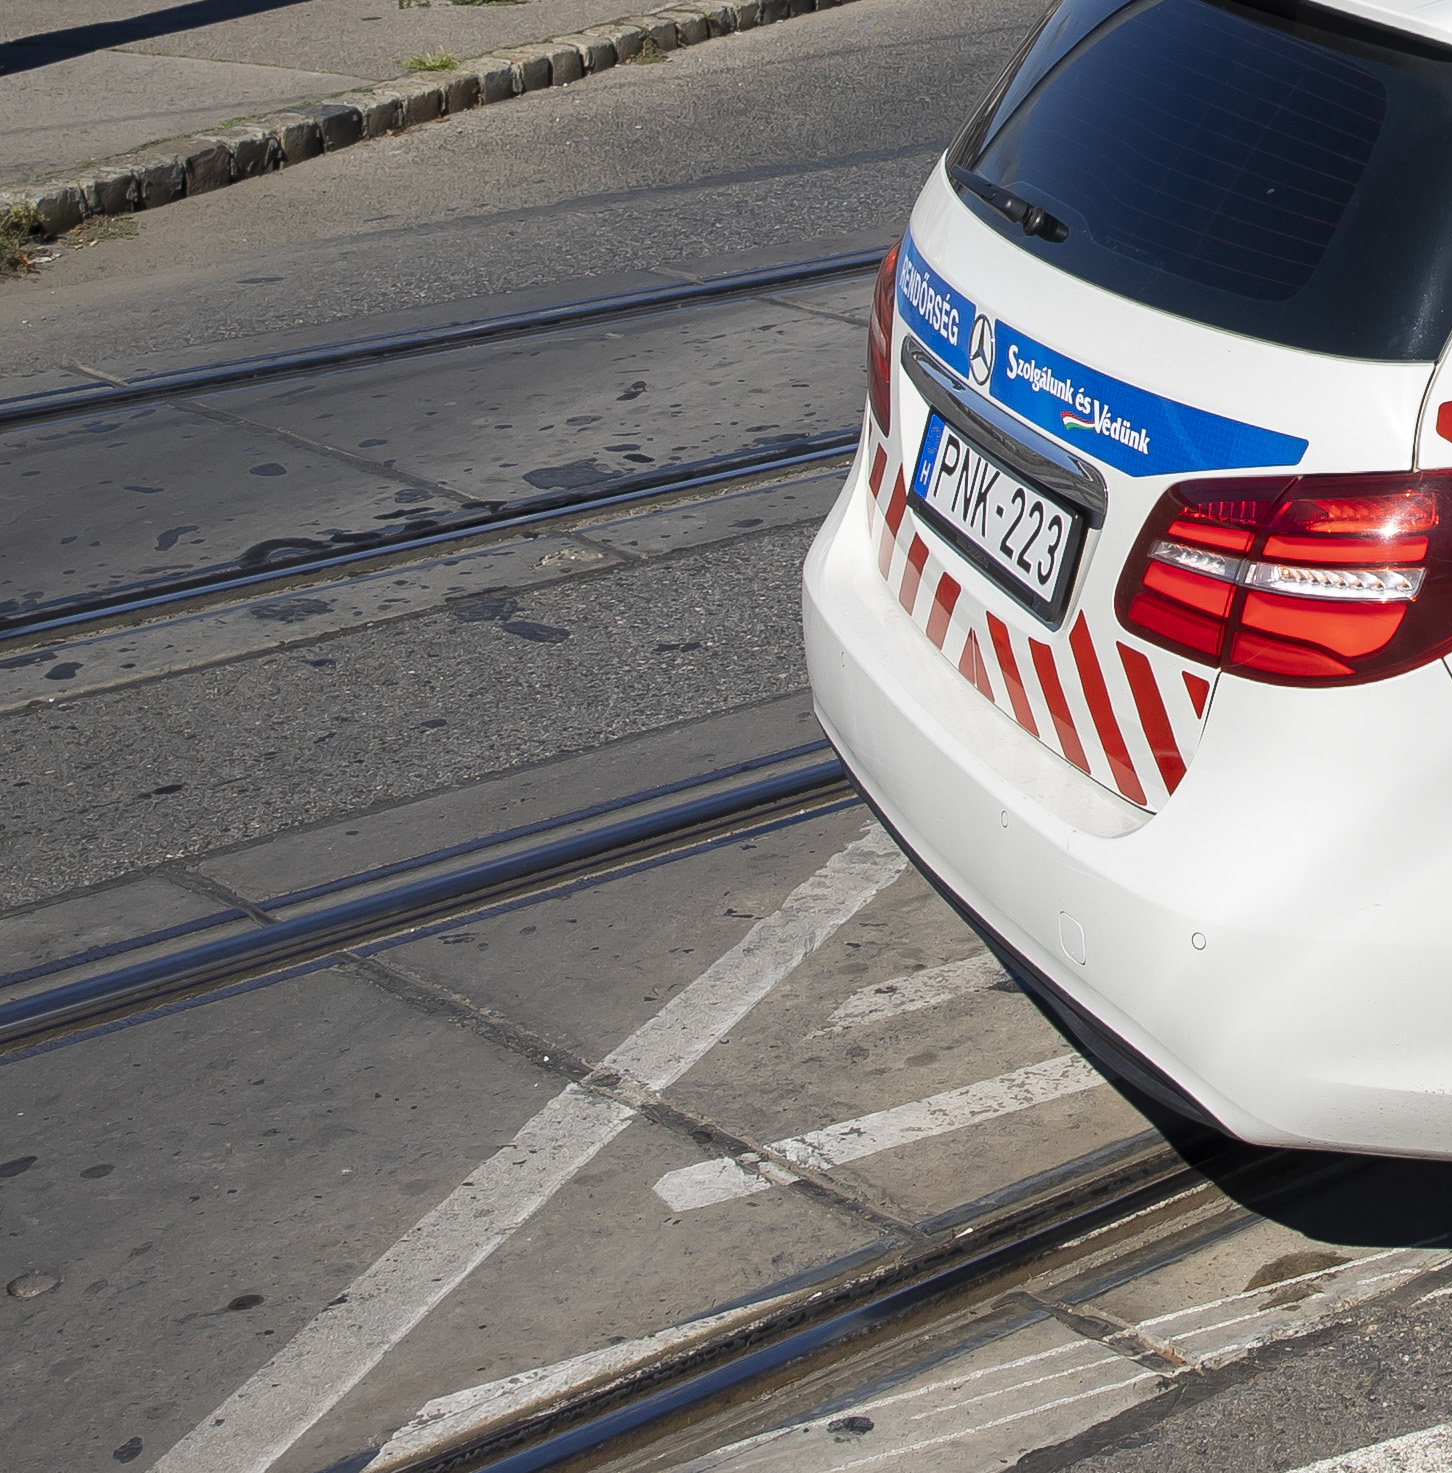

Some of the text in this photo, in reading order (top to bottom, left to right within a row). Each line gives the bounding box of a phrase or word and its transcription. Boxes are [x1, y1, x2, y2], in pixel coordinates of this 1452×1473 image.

[898, 254, 960, 347] RENDŐRSÉG
[1006, 344, 1151, 455] Szolgálunk és Védünk
[919, 459, 931, 486] H
[932, 433, 1064, 586] PNK-223
